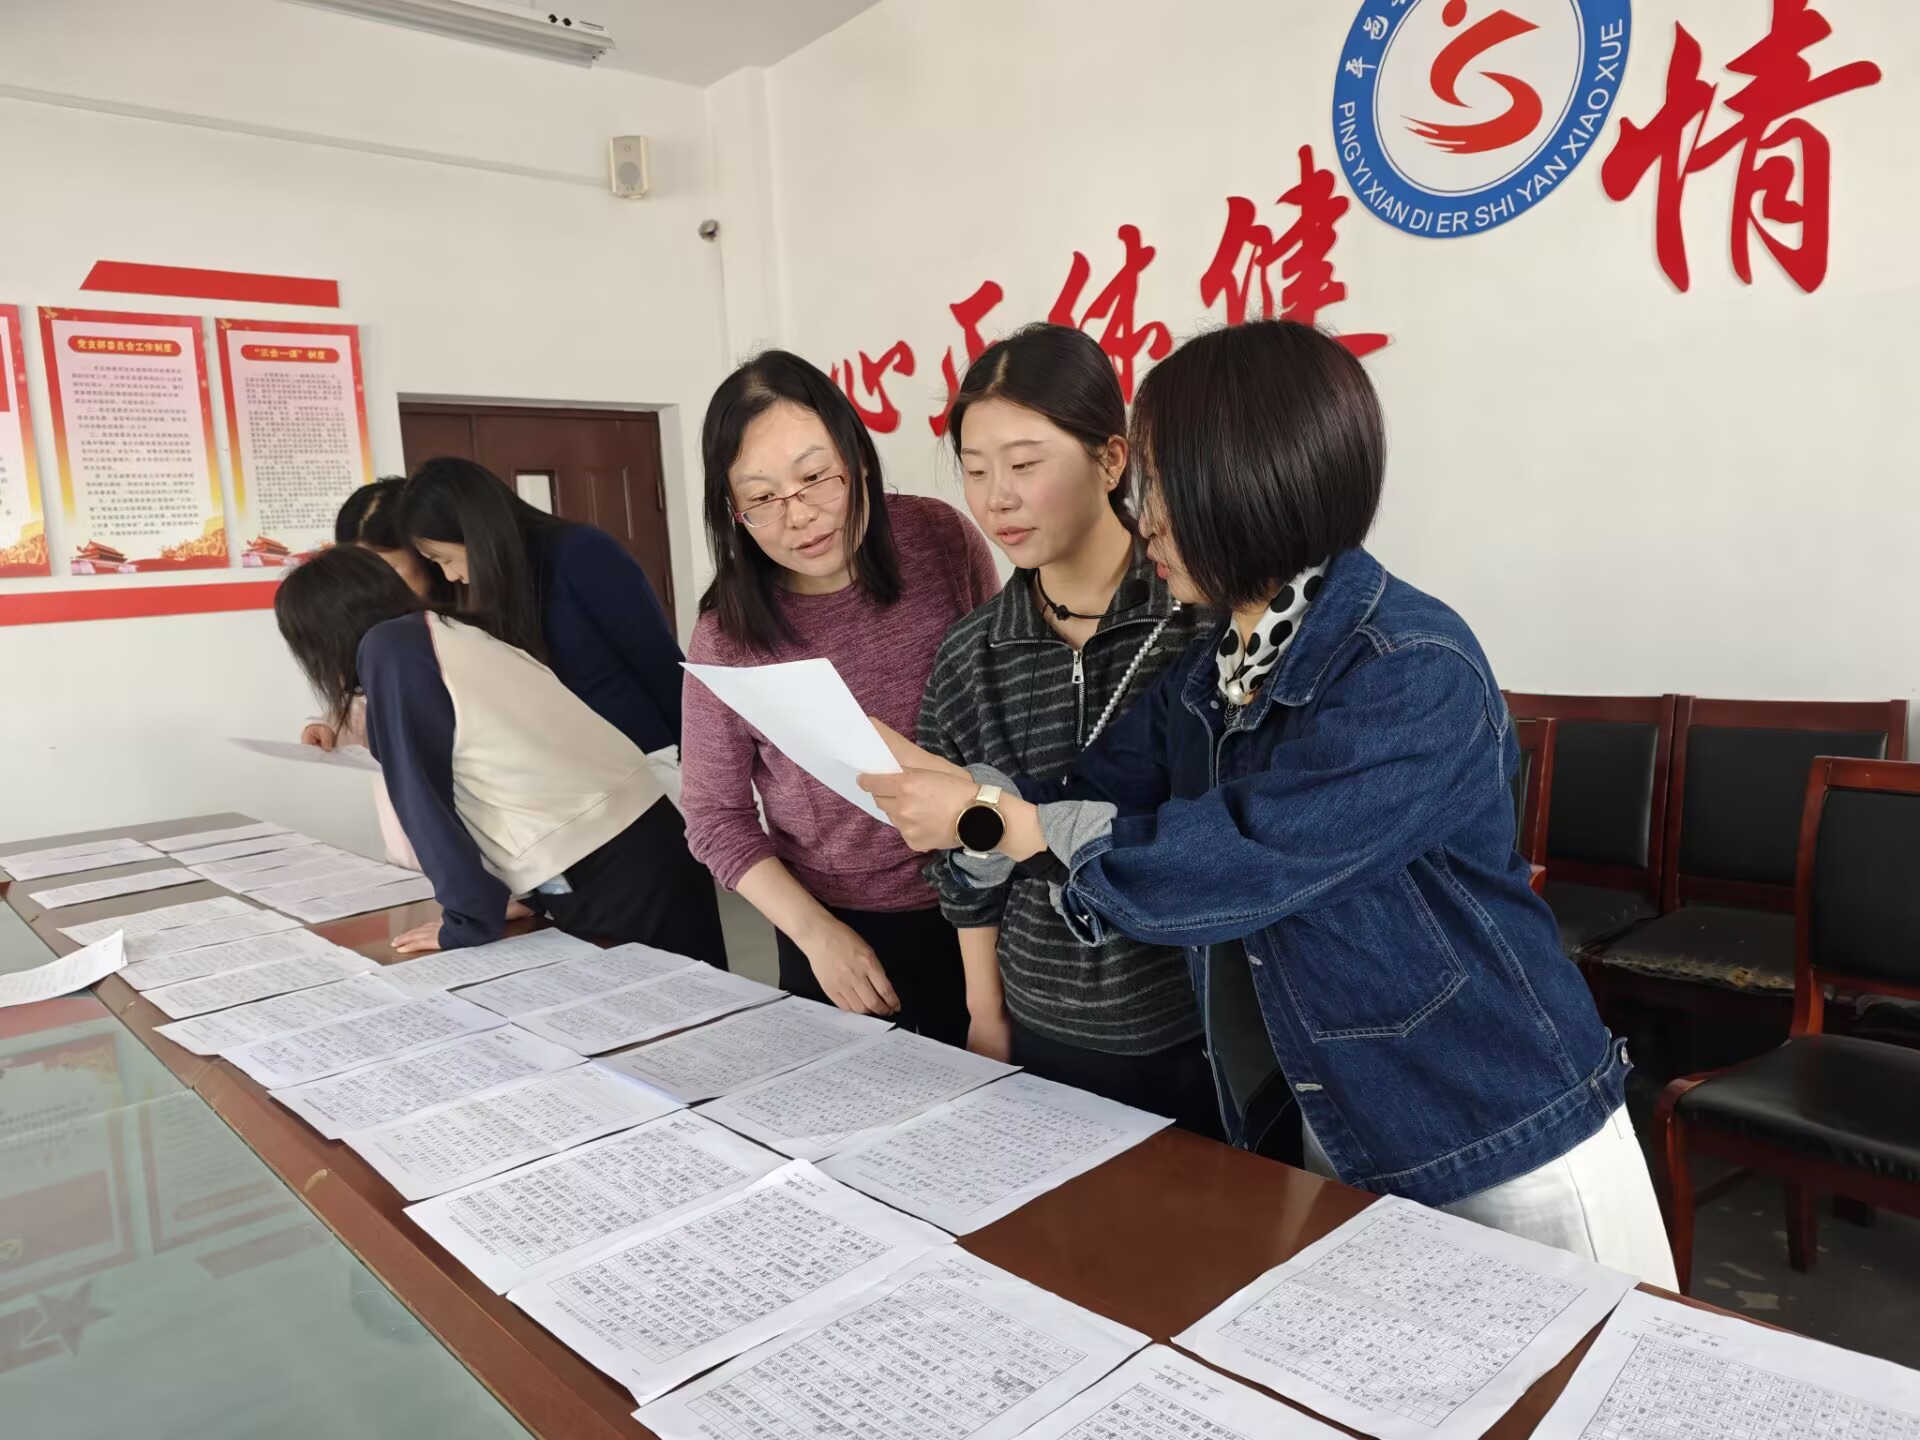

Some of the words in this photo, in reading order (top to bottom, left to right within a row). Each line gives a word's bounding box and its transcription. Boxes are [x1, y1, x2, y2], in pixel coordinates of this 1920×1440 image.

[1339, 101, 1361, 162] PING
[1352, 158, 1373, 187] YI
[1363, 179, 1411, 224] XIAN
[1409, 208, 1433, 232] DI
[1436, 211, 1469, 233] ER
[1475, 194, 1516, 227] SHI
[1516, 155, 1568, 203] YAN
[1561, 88, 1610, 160] XIAO
[1595, 19, 1623, 82] XUE
[1601, 0, 1882, 293] 情
